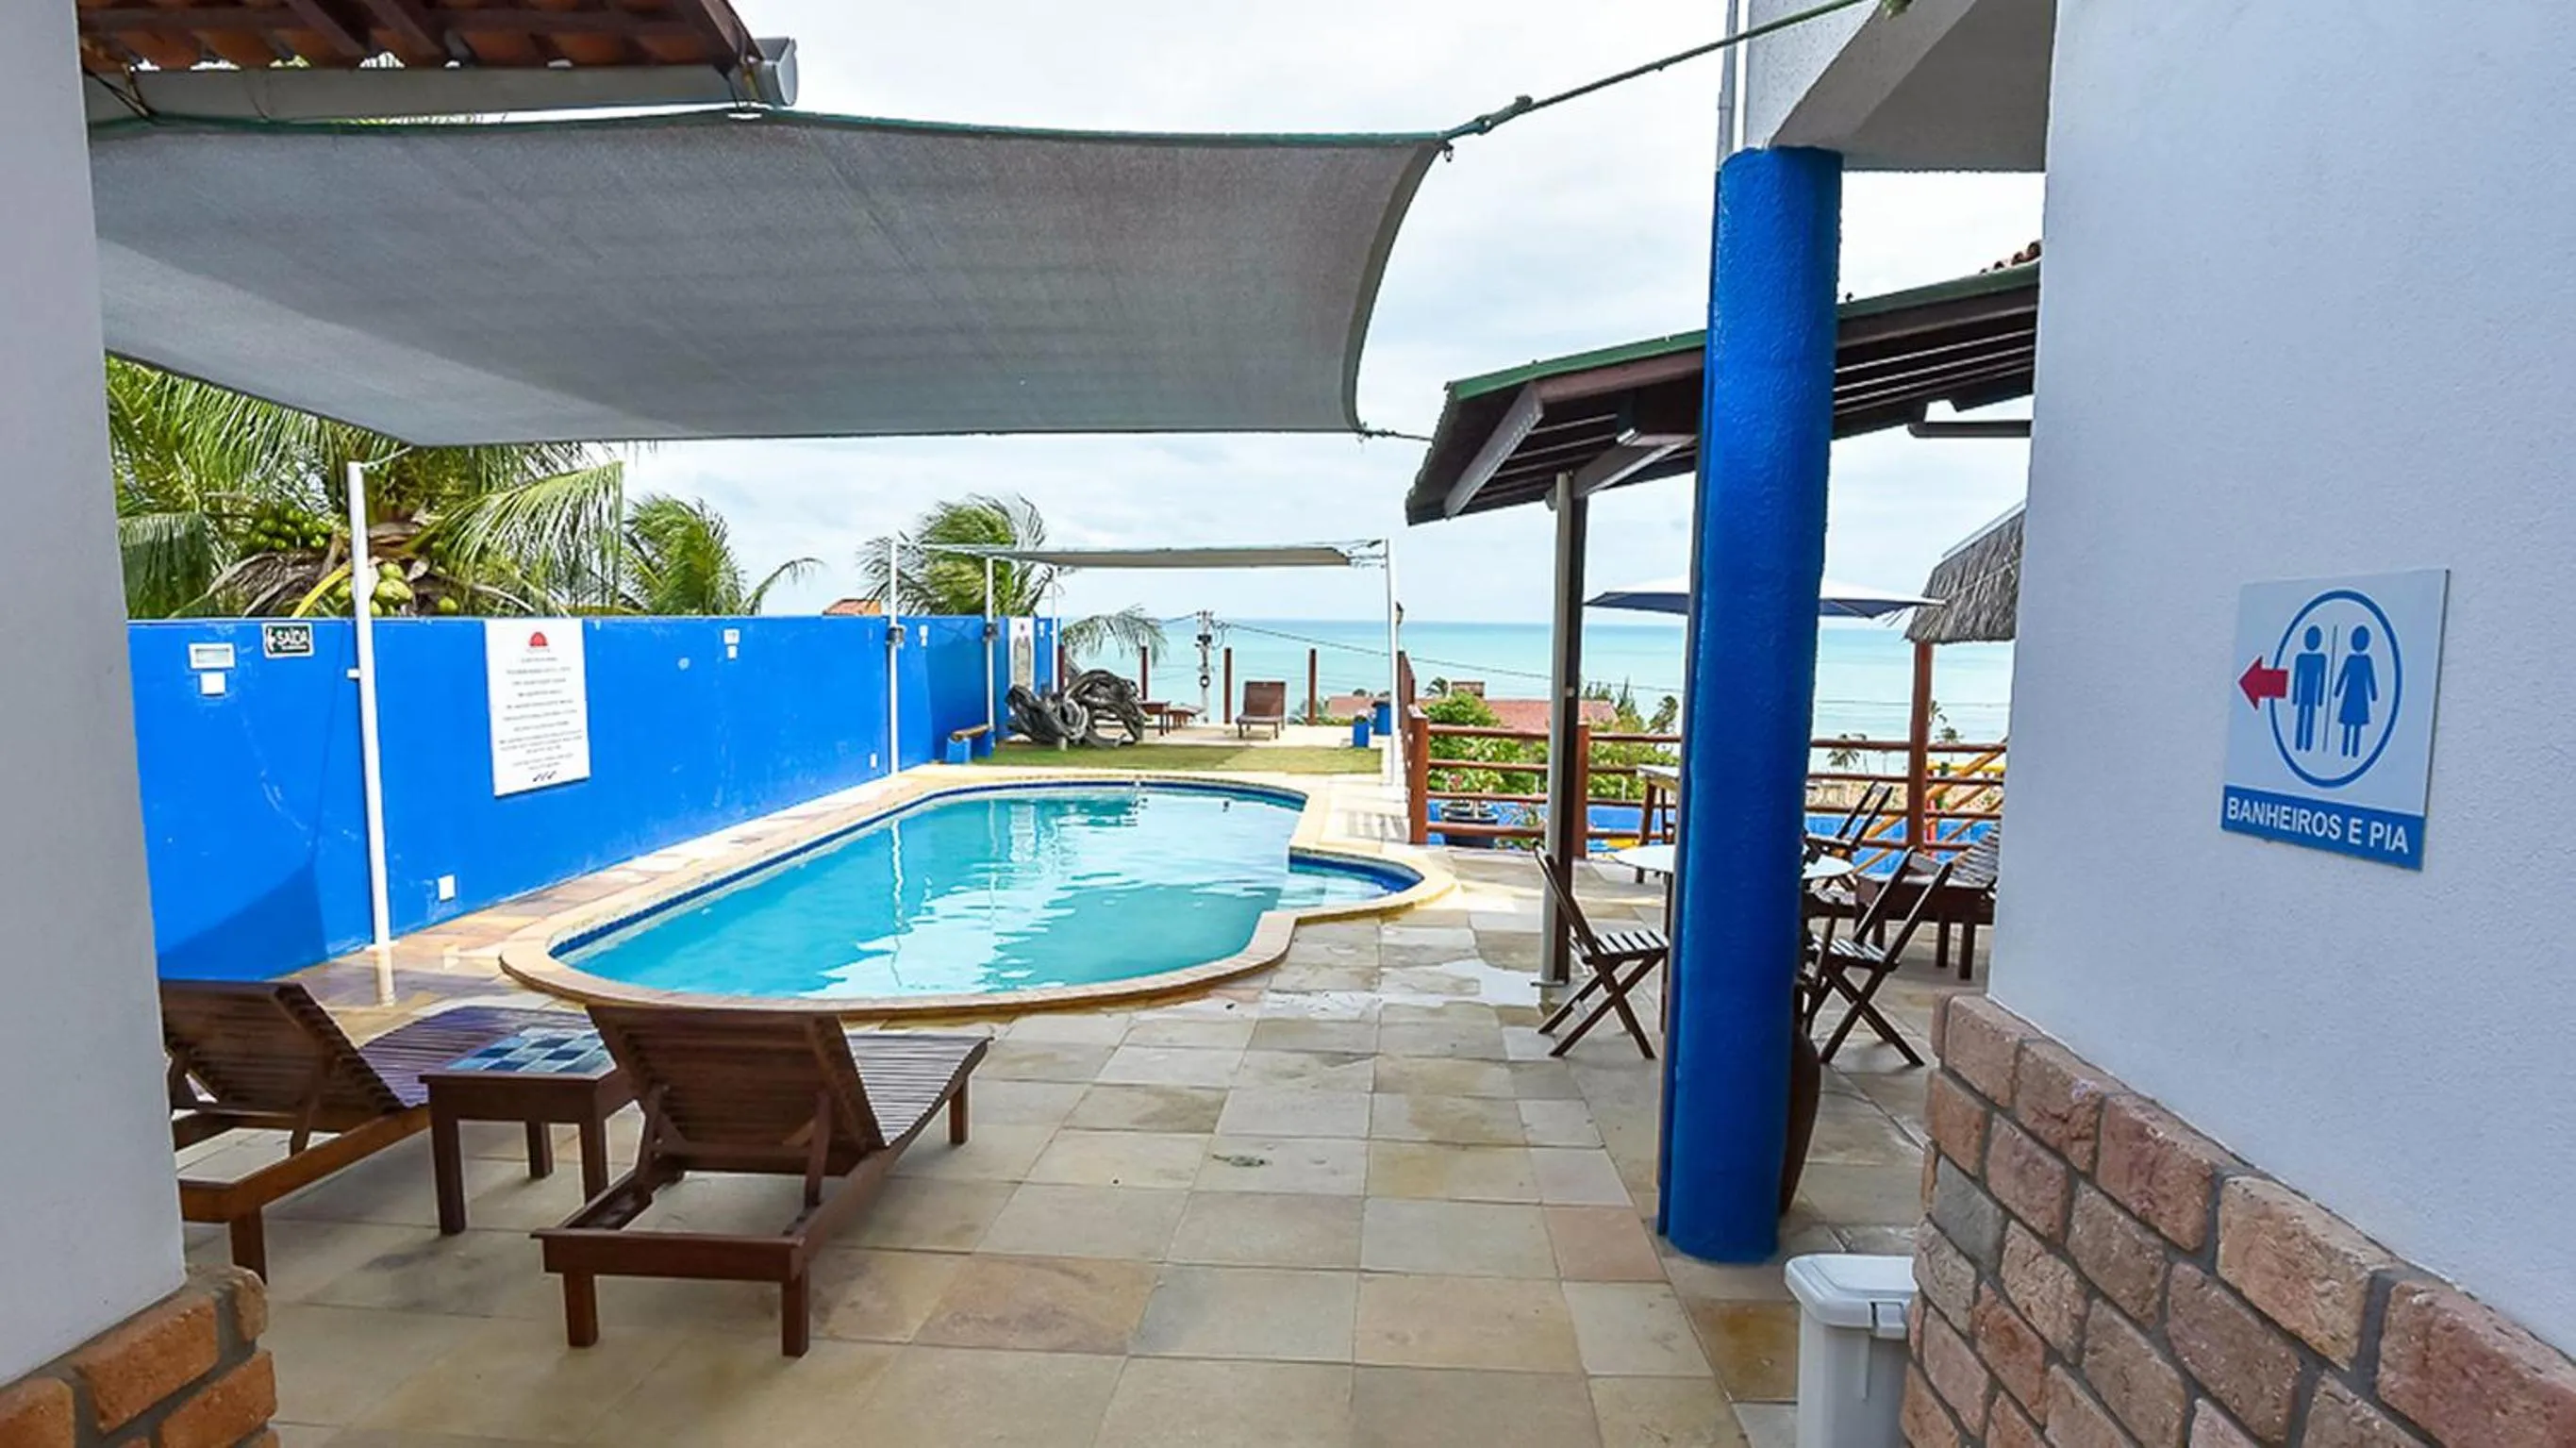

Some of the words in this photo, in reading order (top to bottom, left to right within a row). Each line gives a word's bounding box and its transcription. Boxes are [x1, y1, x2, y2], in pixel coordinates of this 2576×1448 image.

[2226, 796, 2342, 841] BANHEIROS
[2348, 817, 2364, 845] E
[2368, 821, 2409, 854] PIA
